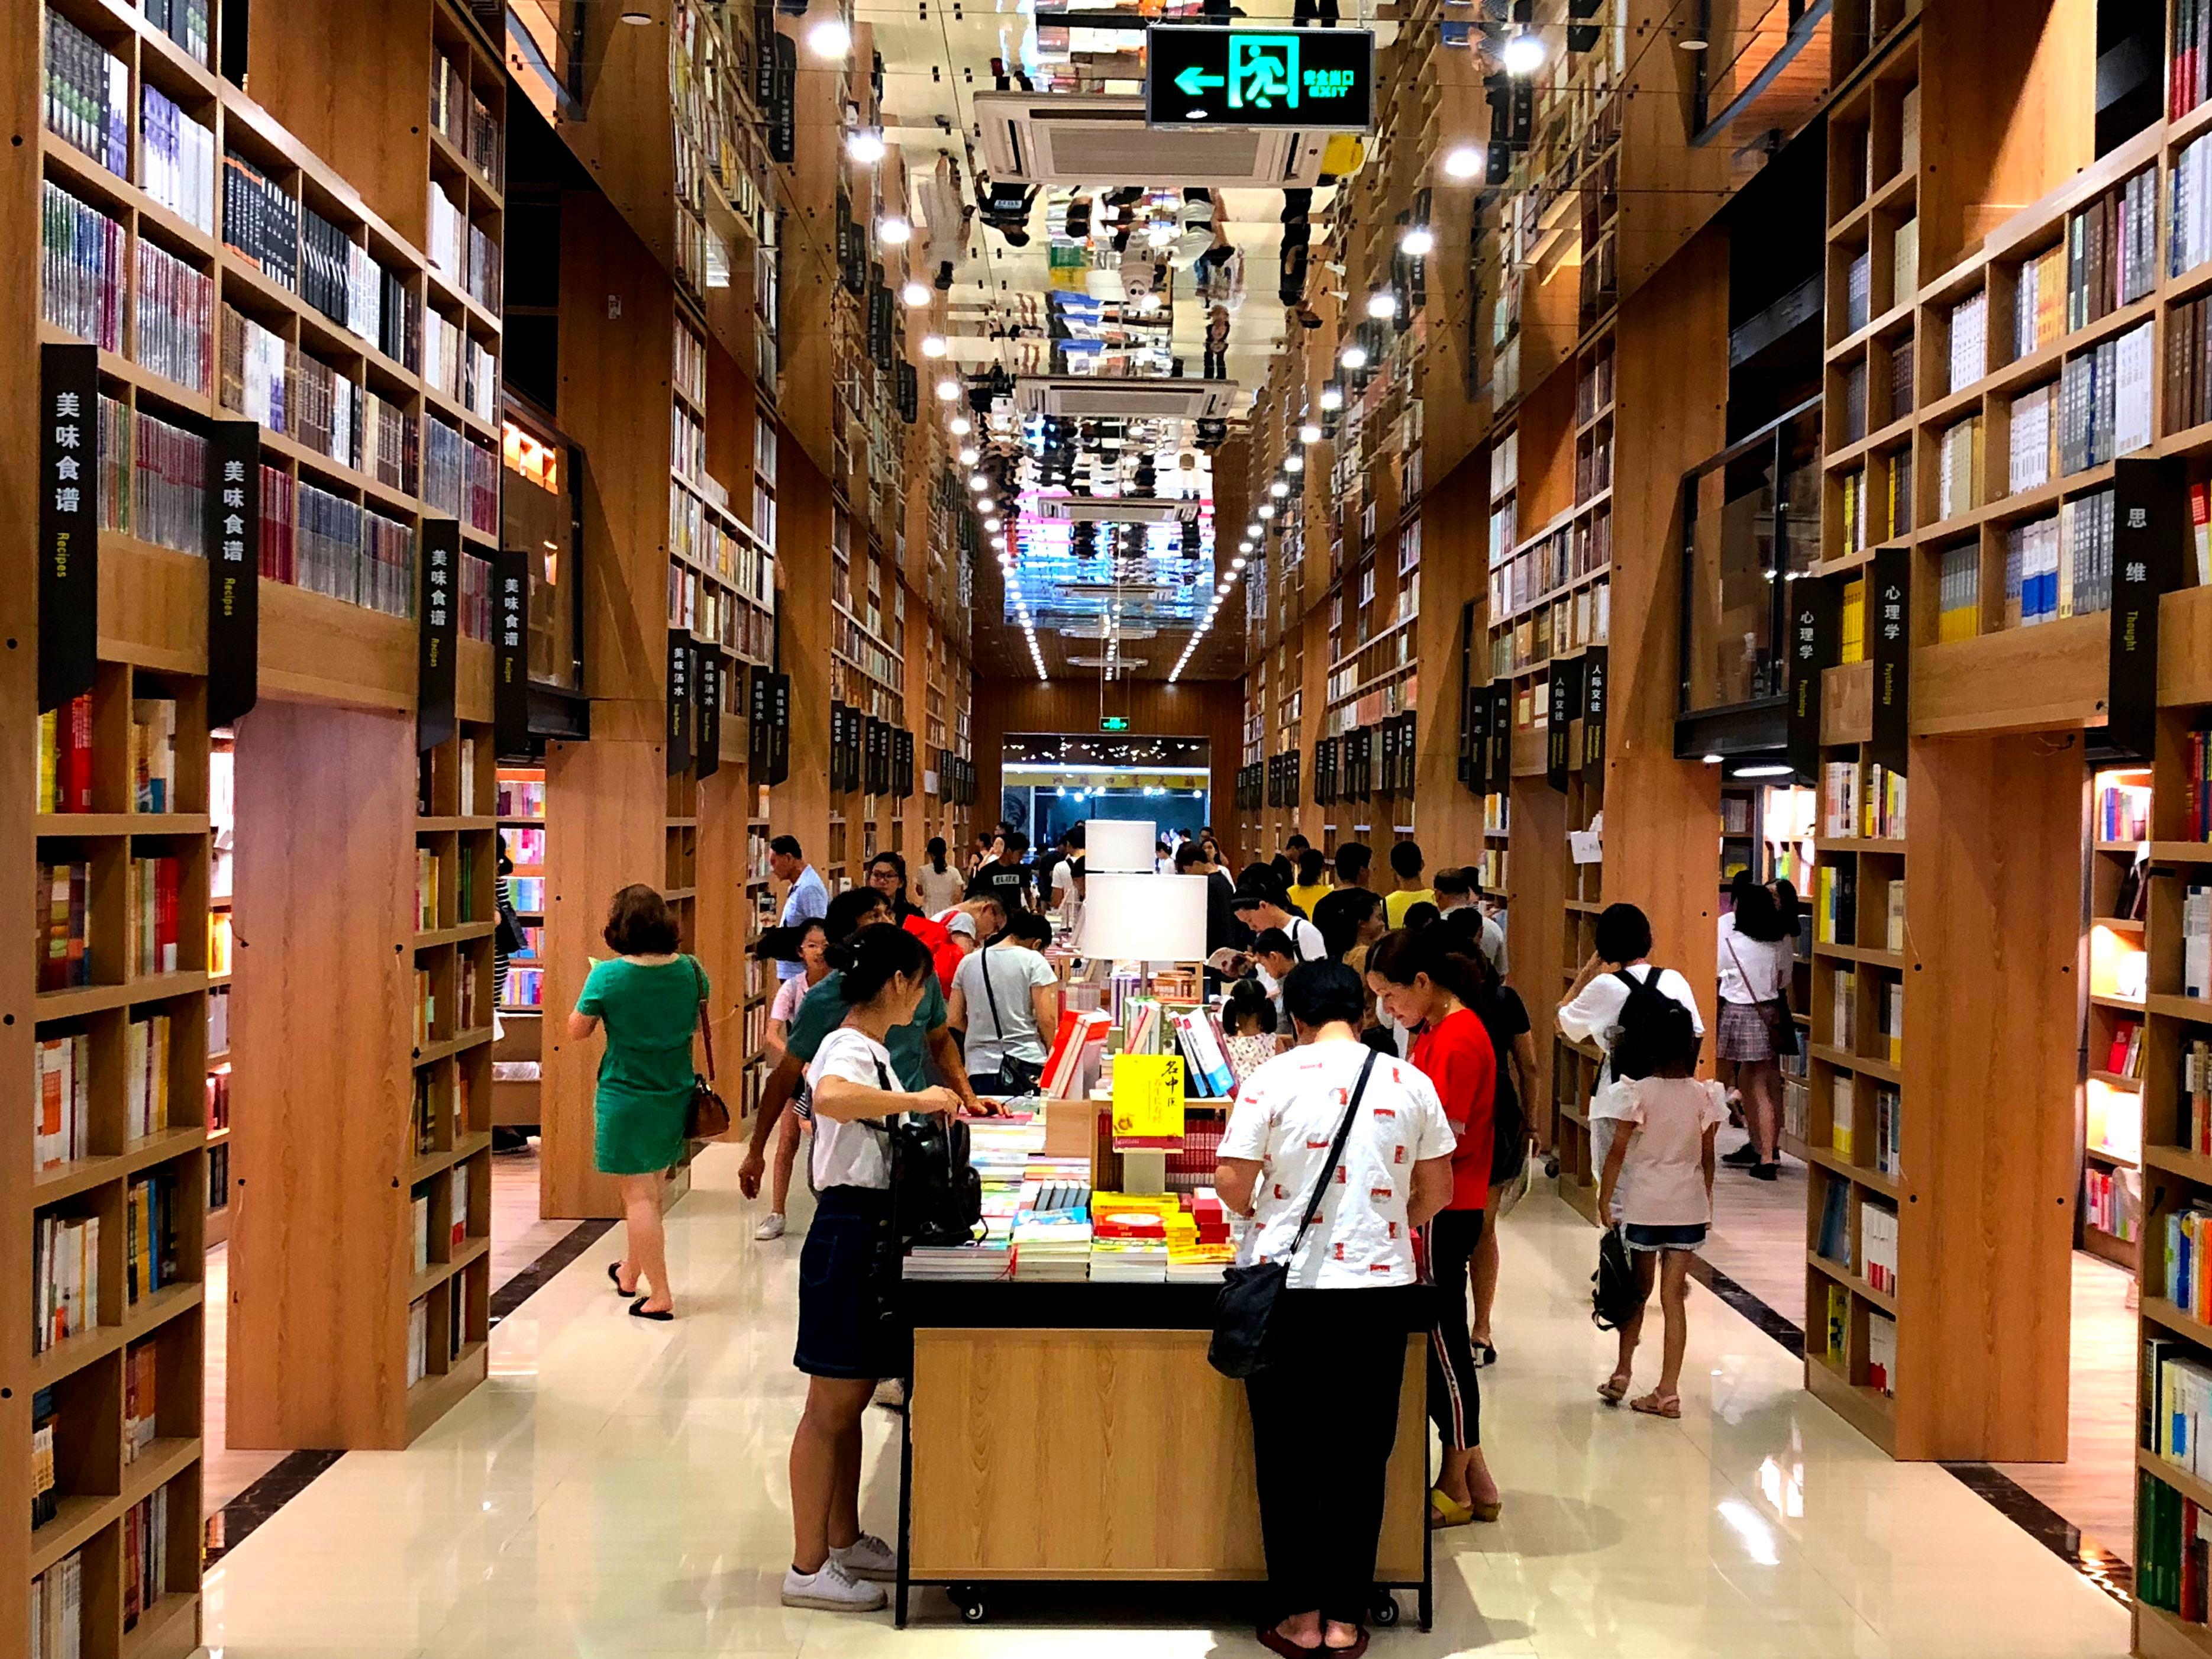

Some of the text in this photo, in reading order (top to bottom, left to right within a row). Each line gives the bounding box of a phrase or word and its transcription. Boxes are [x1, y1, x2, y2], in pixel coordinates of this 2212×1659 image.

[1303, 70, 1354, 86] 安全出口
[1309, 86, 1348, 97] EXIT
[55, 392, 80, 512] 美味食谱
[222, 460, 244, 561] 美味食谱
[54, 532, 70, 577] Recipes
[2126, 508, 2147, 583] 思维
[222, 577, 236, 616] Recipes
[430, 549, 447, 626] 美味食谱
[504, 578, 519, 646] 美味食谱
[1799, 611, 1814, 659] 心理学
[1884, 585, 1901, 640] 心理学
[2123, 611, 2139, 651] Thought
[1555, 677, 1565, 721] 人际交往
[1590, 664, 1602, 712] 人际交往
[1882, 663, 1894, 705] Psychology
[1161, 1060, 1179, 1107] 名中医
